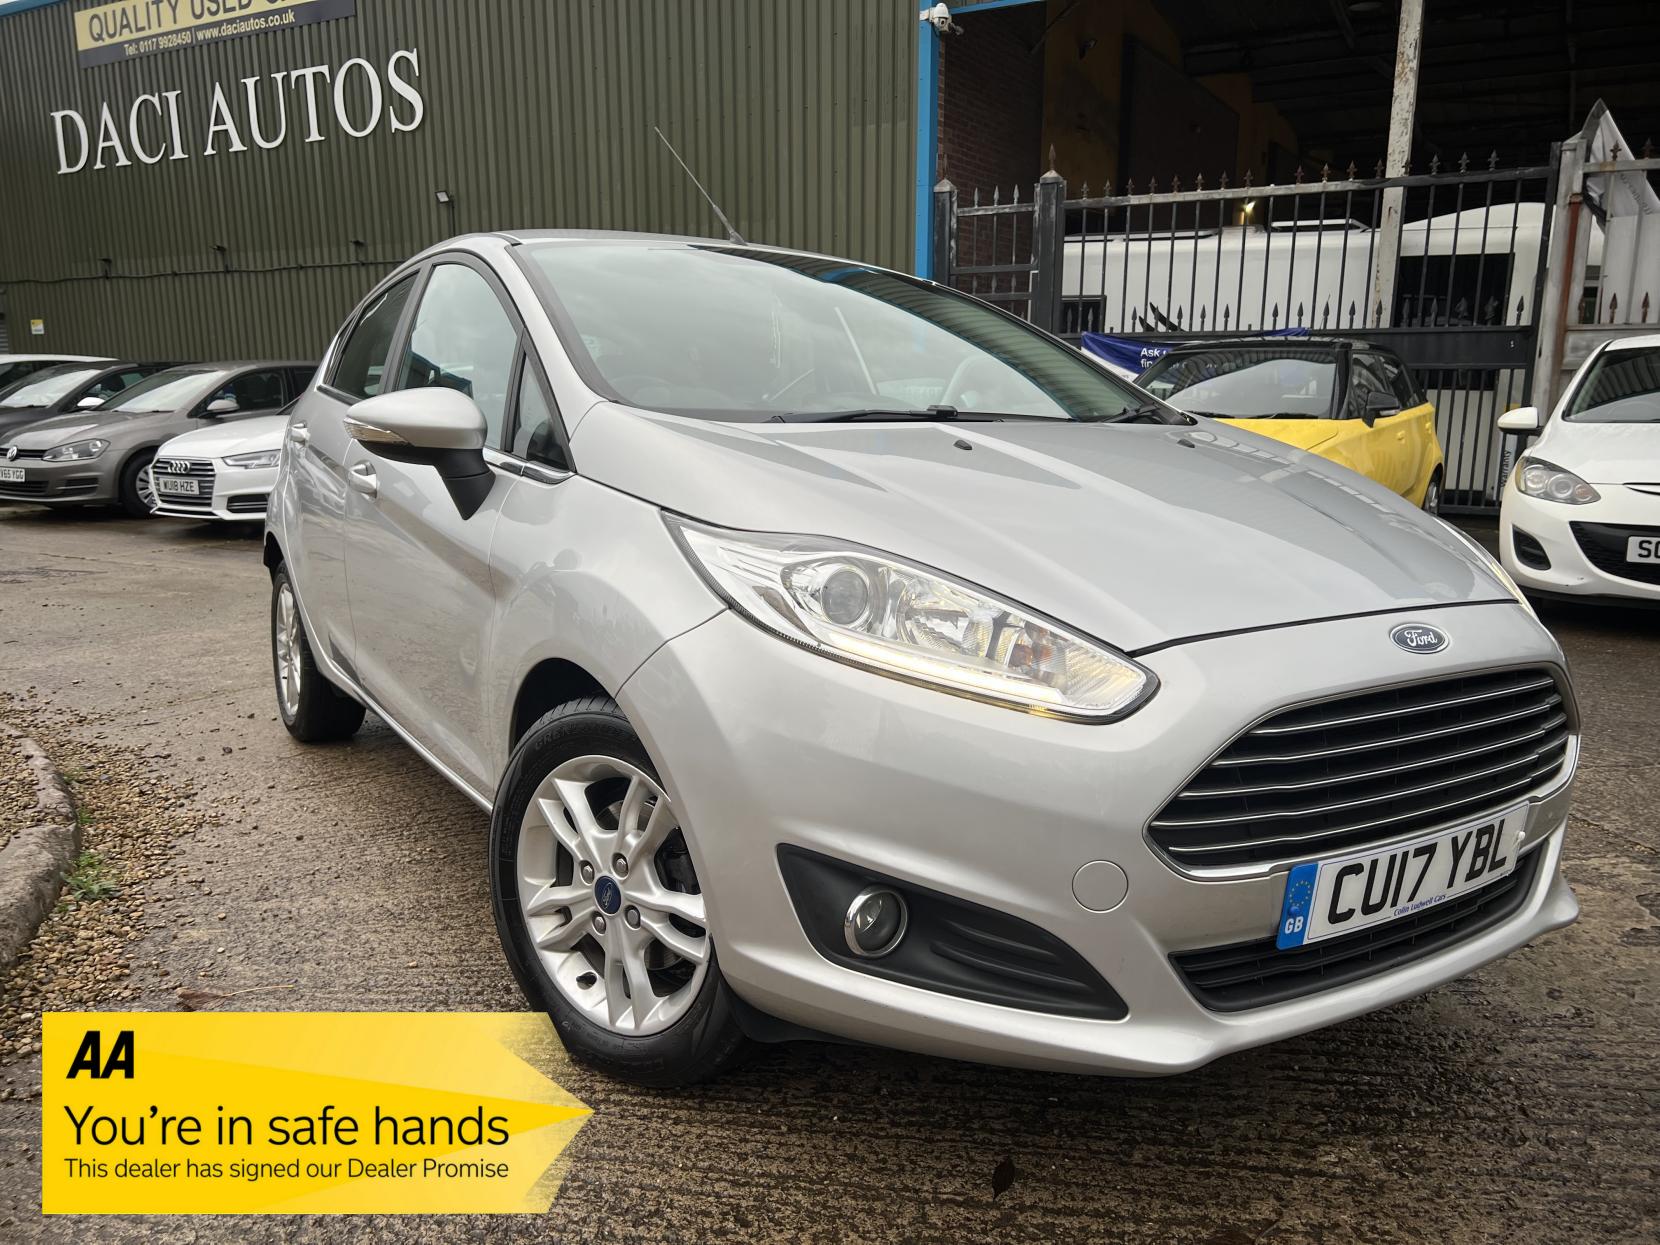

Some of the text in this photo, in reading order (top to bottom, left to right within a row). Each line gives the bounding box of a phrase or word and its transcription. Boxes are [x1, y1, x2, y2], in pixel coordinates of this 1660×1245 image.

[89, 0, 179, 42] QUALITY
[123, 43, 139, 56] Tel:
[139, 38, 157, 53] 0117
[196, 9, 295, 40] www.daciautos.co.uk
[50, 47, 425, 175] DACI AUTOS
[1140, 347, 1160, 357] Ask
[180, 480, 196, 493] HZE
[1404, 629, 1438, 647] Ford
[1327, 818, 1508, 925] CU17 YBL
[1284, 915, 1304, 934] GB
